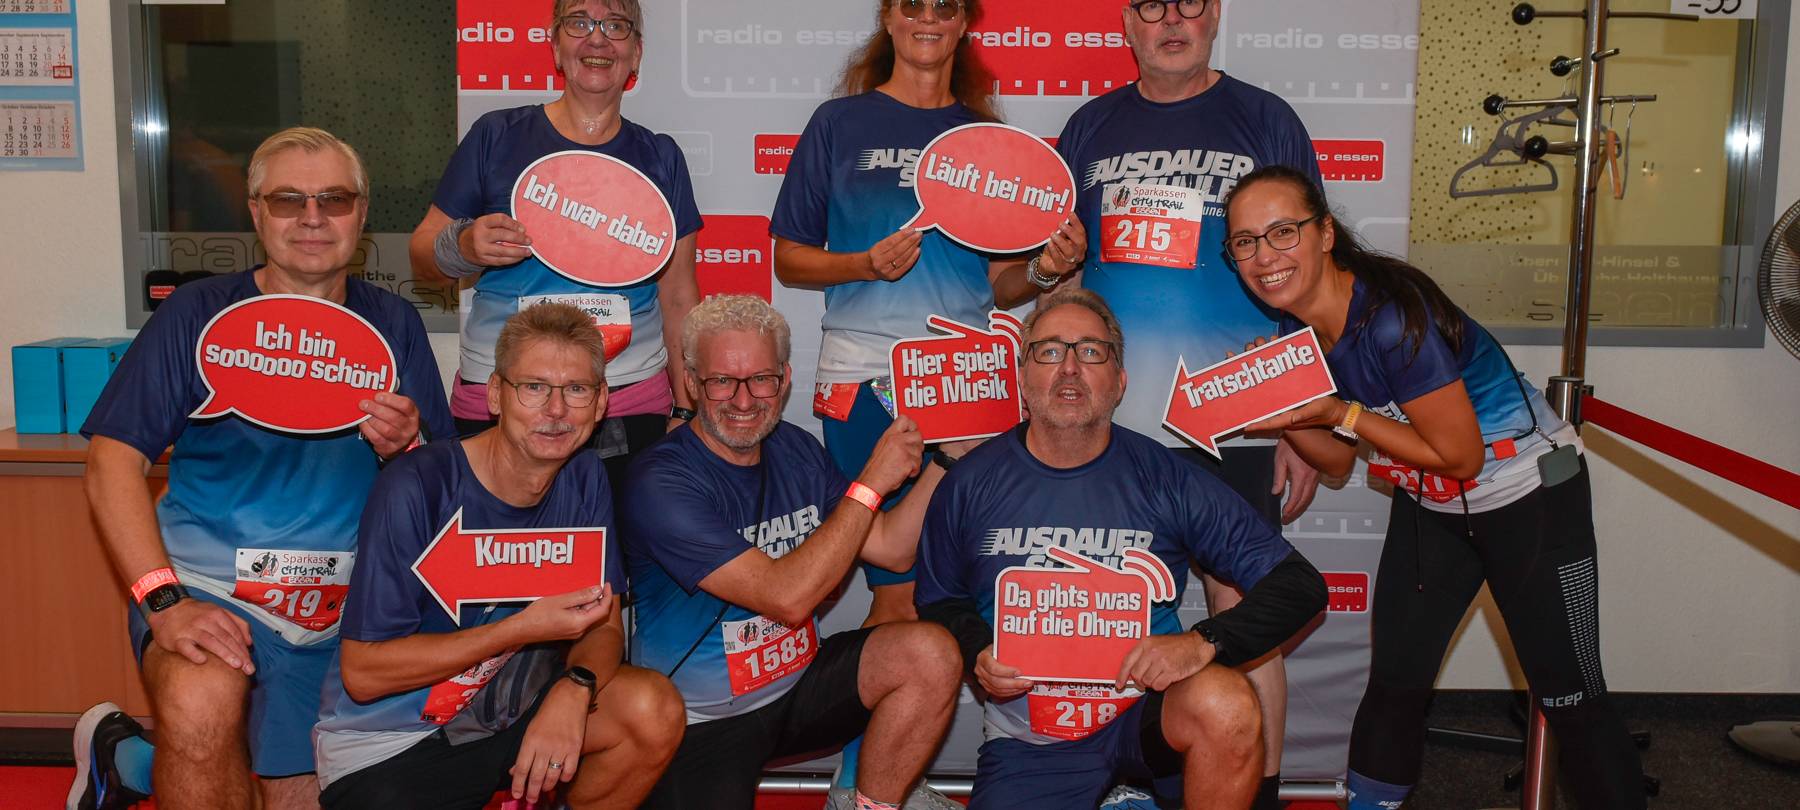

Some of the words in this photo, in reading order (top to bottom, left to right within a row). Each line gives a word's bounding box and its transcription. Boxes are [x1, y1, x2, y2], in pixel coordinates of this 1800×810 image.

[697, 24, 783, 45] radio
[967, 26, 1052, 48] radio
[1236, 28, 1324, 49] radio
[1337, 33, 1419, 50] esse
[758, 146, 794, 156] radio
[1334, 153, 1379, 162] essen
[1088, 150, 1255, 186] AUSDAUER
[924, 153, 981, 193] Läuft
[983, 171, 1021, 202] bei
[1021, 186, 1070, 214] mir!
[1134, 187, 1186, 198] Sparkassen
[523, 174, 559, 212] Ich
[560, 197, 607, 230] war
[608, 214, 668, 256] dabei
[1114, 219, 1171, 251] 215
[557, 297, 612, 305] Sparkassen
[255, 321, 292, 350] Ich
[298, 328, 336, 358] bin
[205, 344, 307, 379] soooooo
[310, 357, 388, 390] schön!
[901, 348, 947, 378] Hier
[952, 342, 1008, 379] spielt
[904, 379, 938, 408] die
[941, 373, 1009, 404] Musik
[1180, 343, 1316, 409] Tratschtante
[474, 534, 575, 568] Kumpel
[986, 526, 1154, 556] AUSDAUER
[283, 553, 339, 565] Sparkassn
[263, 589, 322, 617] 219
[1004, 581, 1031, 608] Da
[1036, 582, 1089, 612] gibts
[1095, 591, 1141, 611] was
[1002, 611, 1037, 635] auf
[1041, 611, 1075, 637] die
[1078, 611, 1142, 639] Ohren
[744, 626, 810, 679] 1583
[1055, 701, 1117, 728] 218
[1555, 691, 1583, 708] cep
